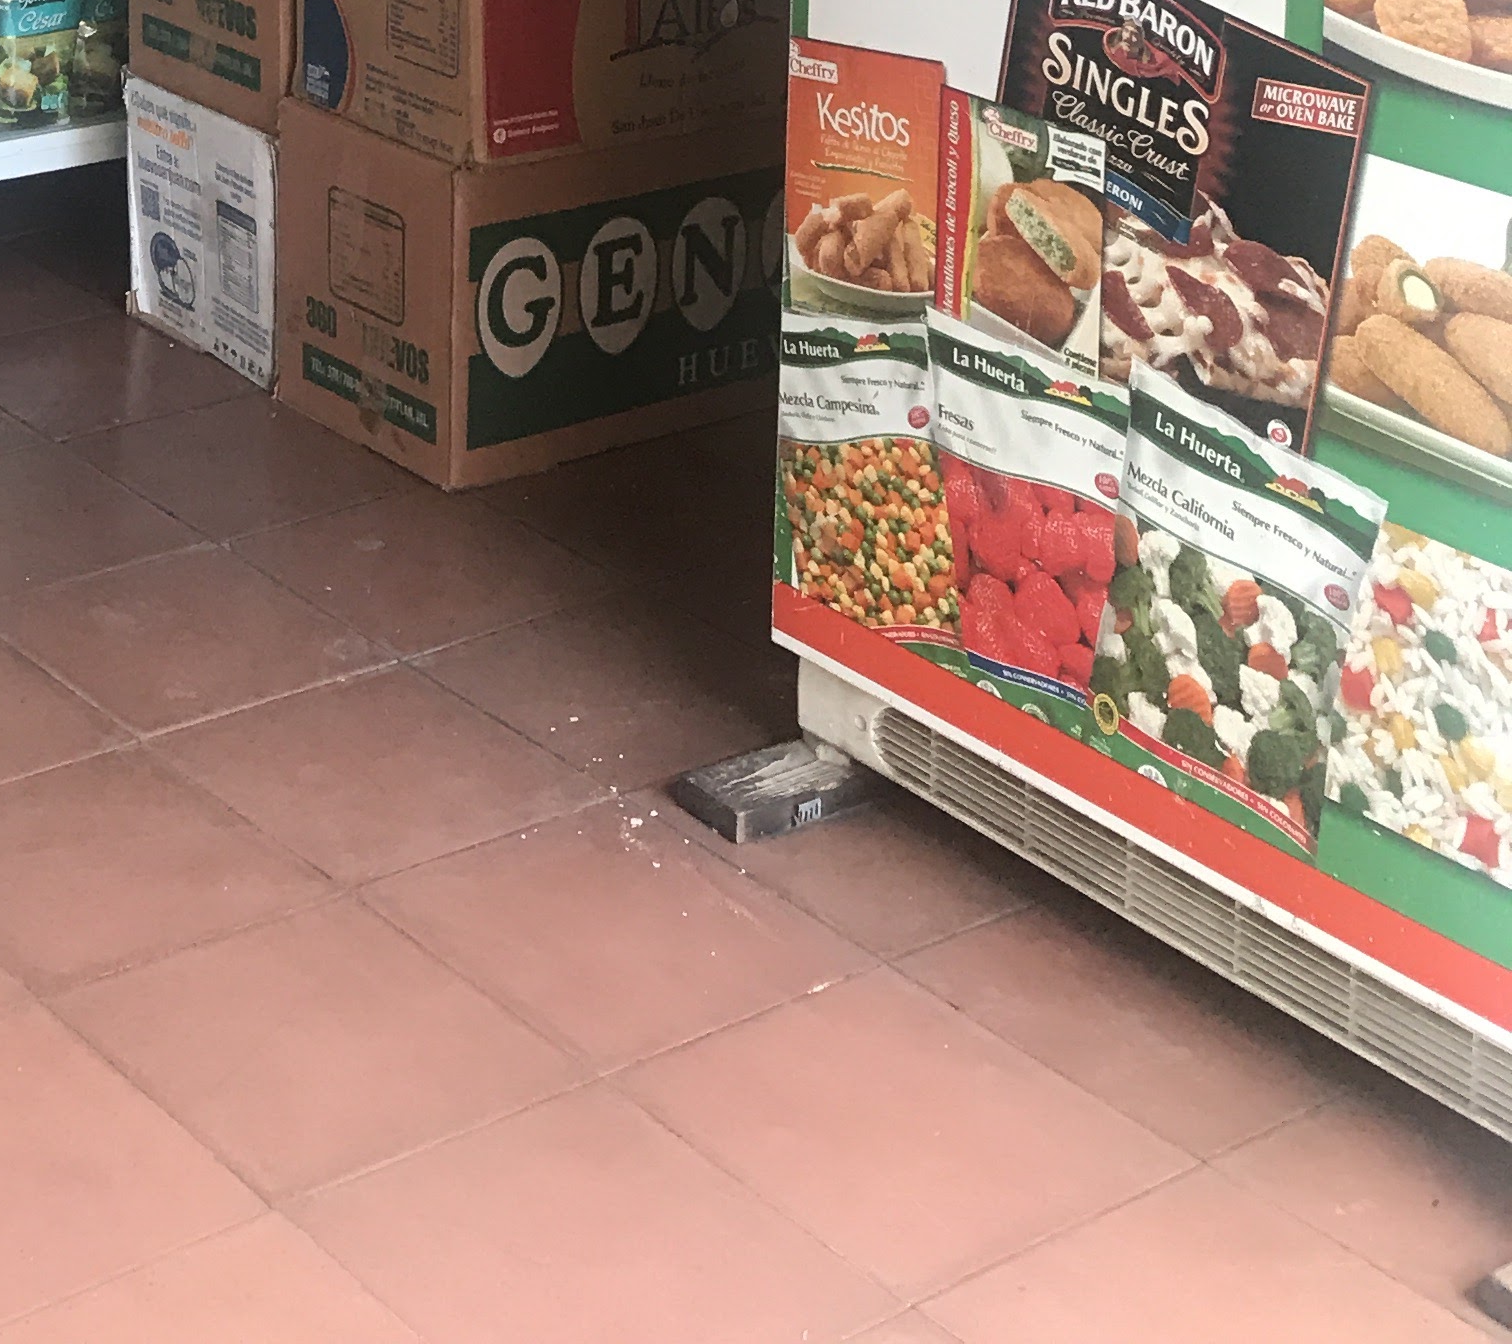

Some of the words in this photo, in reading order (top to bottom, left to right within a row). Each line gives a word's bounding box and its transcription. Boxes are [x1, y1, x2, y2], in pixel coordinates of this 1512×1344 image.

[18, 11, 68, 34] César
[790, 59, 835, 79] Cheffry
[1041, 32, 1210, 156] SINGLES
[1263, 84, 1357, 116] MICROWAVE
[816, 92, 910, 147] Kesitos
[947, 100, 960, 145] Queso
[1259, 102, 1274, 114] or
[1275, 100, 1315, 123] OVEN
[1317, 110, 1355, 131] BAKE
[989, 125, 1036, 150] Cheffry
[1052, 90, 1129, 148] Classic
[1127, 129, 1191, 182] Crust
[948, 149, 960, 159] y
[1105, 180, 1144, 211] ERONI
[945, 213, 956, 233] de
[488, 216, 738, 348] GEN
[783, 339, 797, 355] La
[799, 341, 839, 358] Huerta
[867, 378, 888, 386] Fresco
[952, 347, 970, 367] La
[974, 355, 1026, 393] Huerta
[779, 392, 814, 408] Mezcla
[938, 403, 976, 431] Fresas
[1021, 409, 1053, 429] Siempre
[1055, 422, 1080, 443] Fresco
[1155, 411, 1175, 440] La
[1179, 427, 1242, 480] Huerta
[1127, 461, 1168, 498] Mezcla
[1172, 490, 1235, 541] California
[1231, 500, 1271, 532] Siempre
[1273, 525, 1304, 550] Fresco
[1181, 759, 1192, 773] SIN
[1256, 801, 1269, 815] SIN
